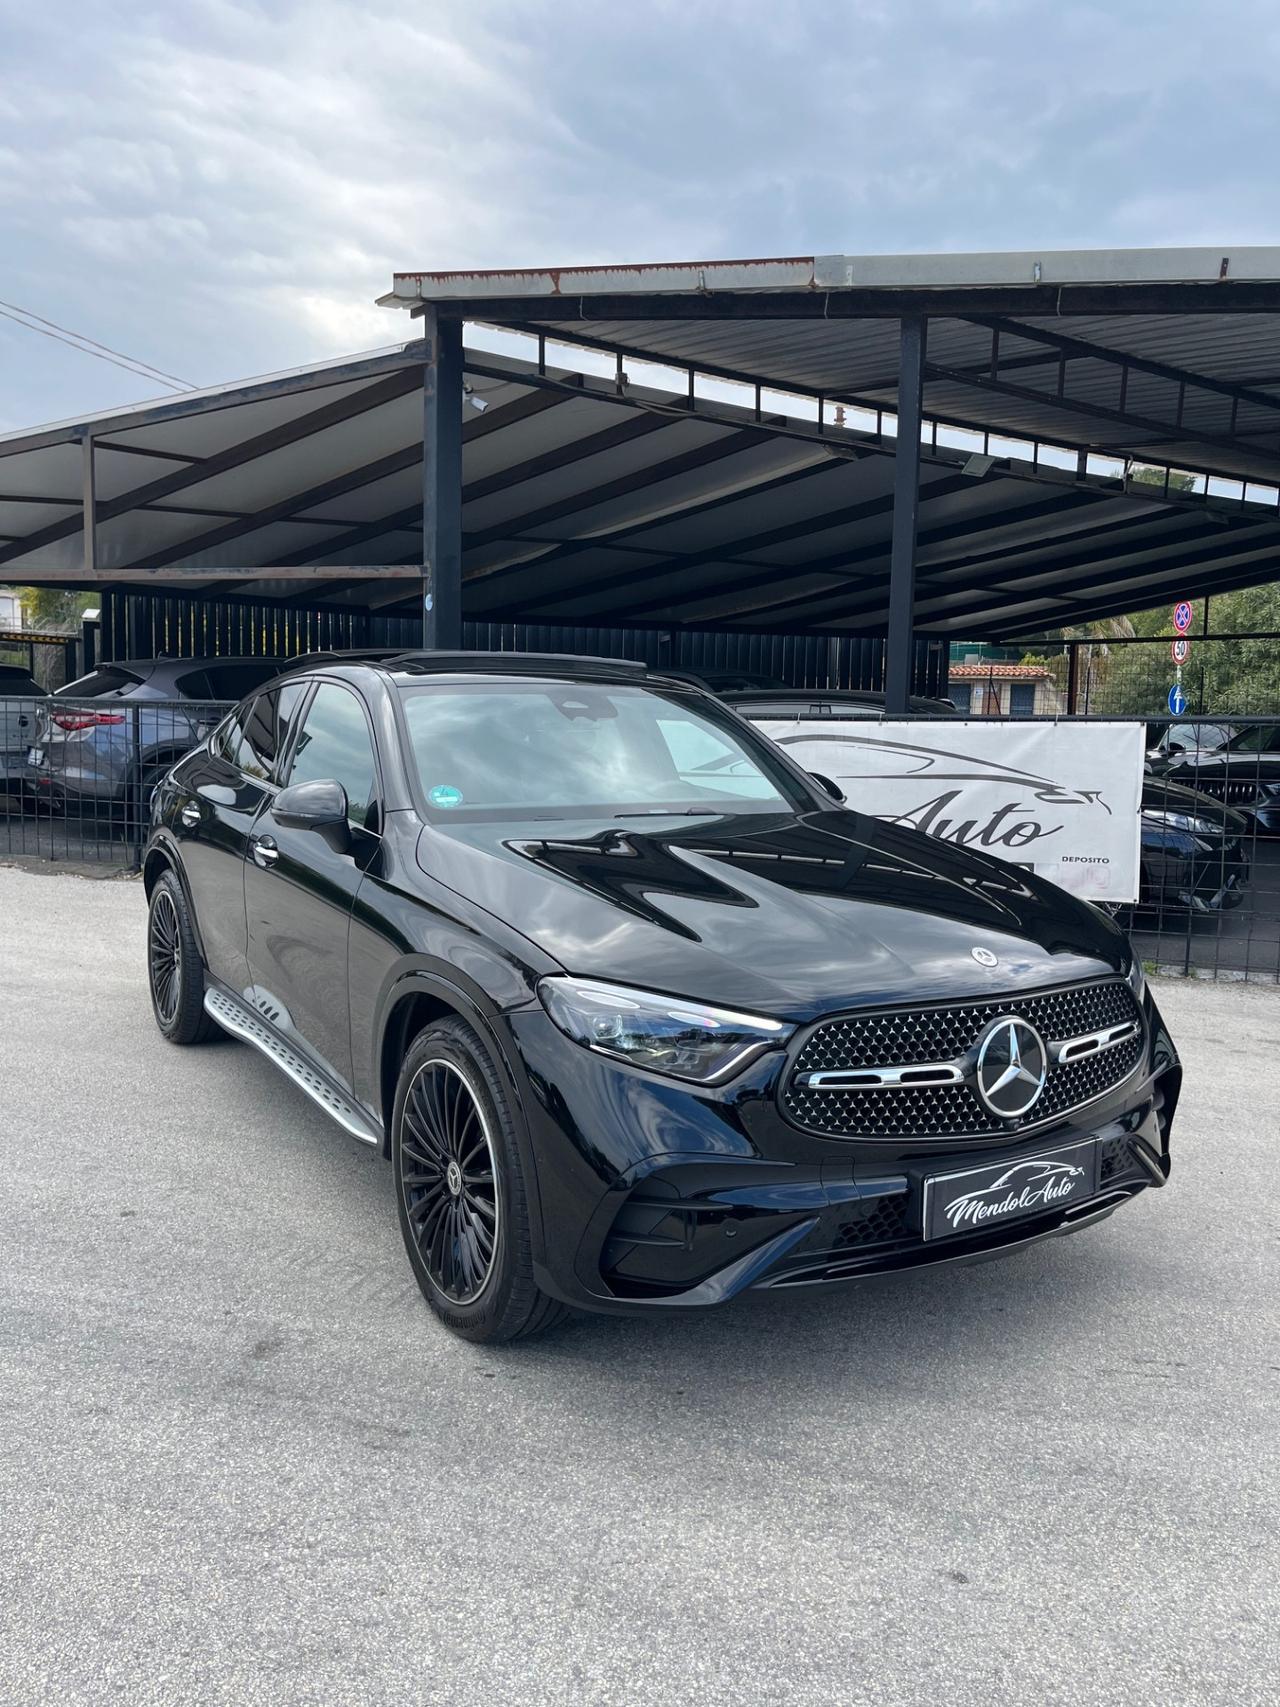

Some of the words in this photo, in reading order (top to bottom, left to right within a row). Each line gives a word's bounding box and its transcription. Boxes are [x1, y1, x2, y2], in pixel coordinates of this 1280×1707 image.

[1176, 640, 1185, 656] 50
[872, 790, 1064, 847] Auto
[1061, 856, 1110, 864] DEPOSITO
